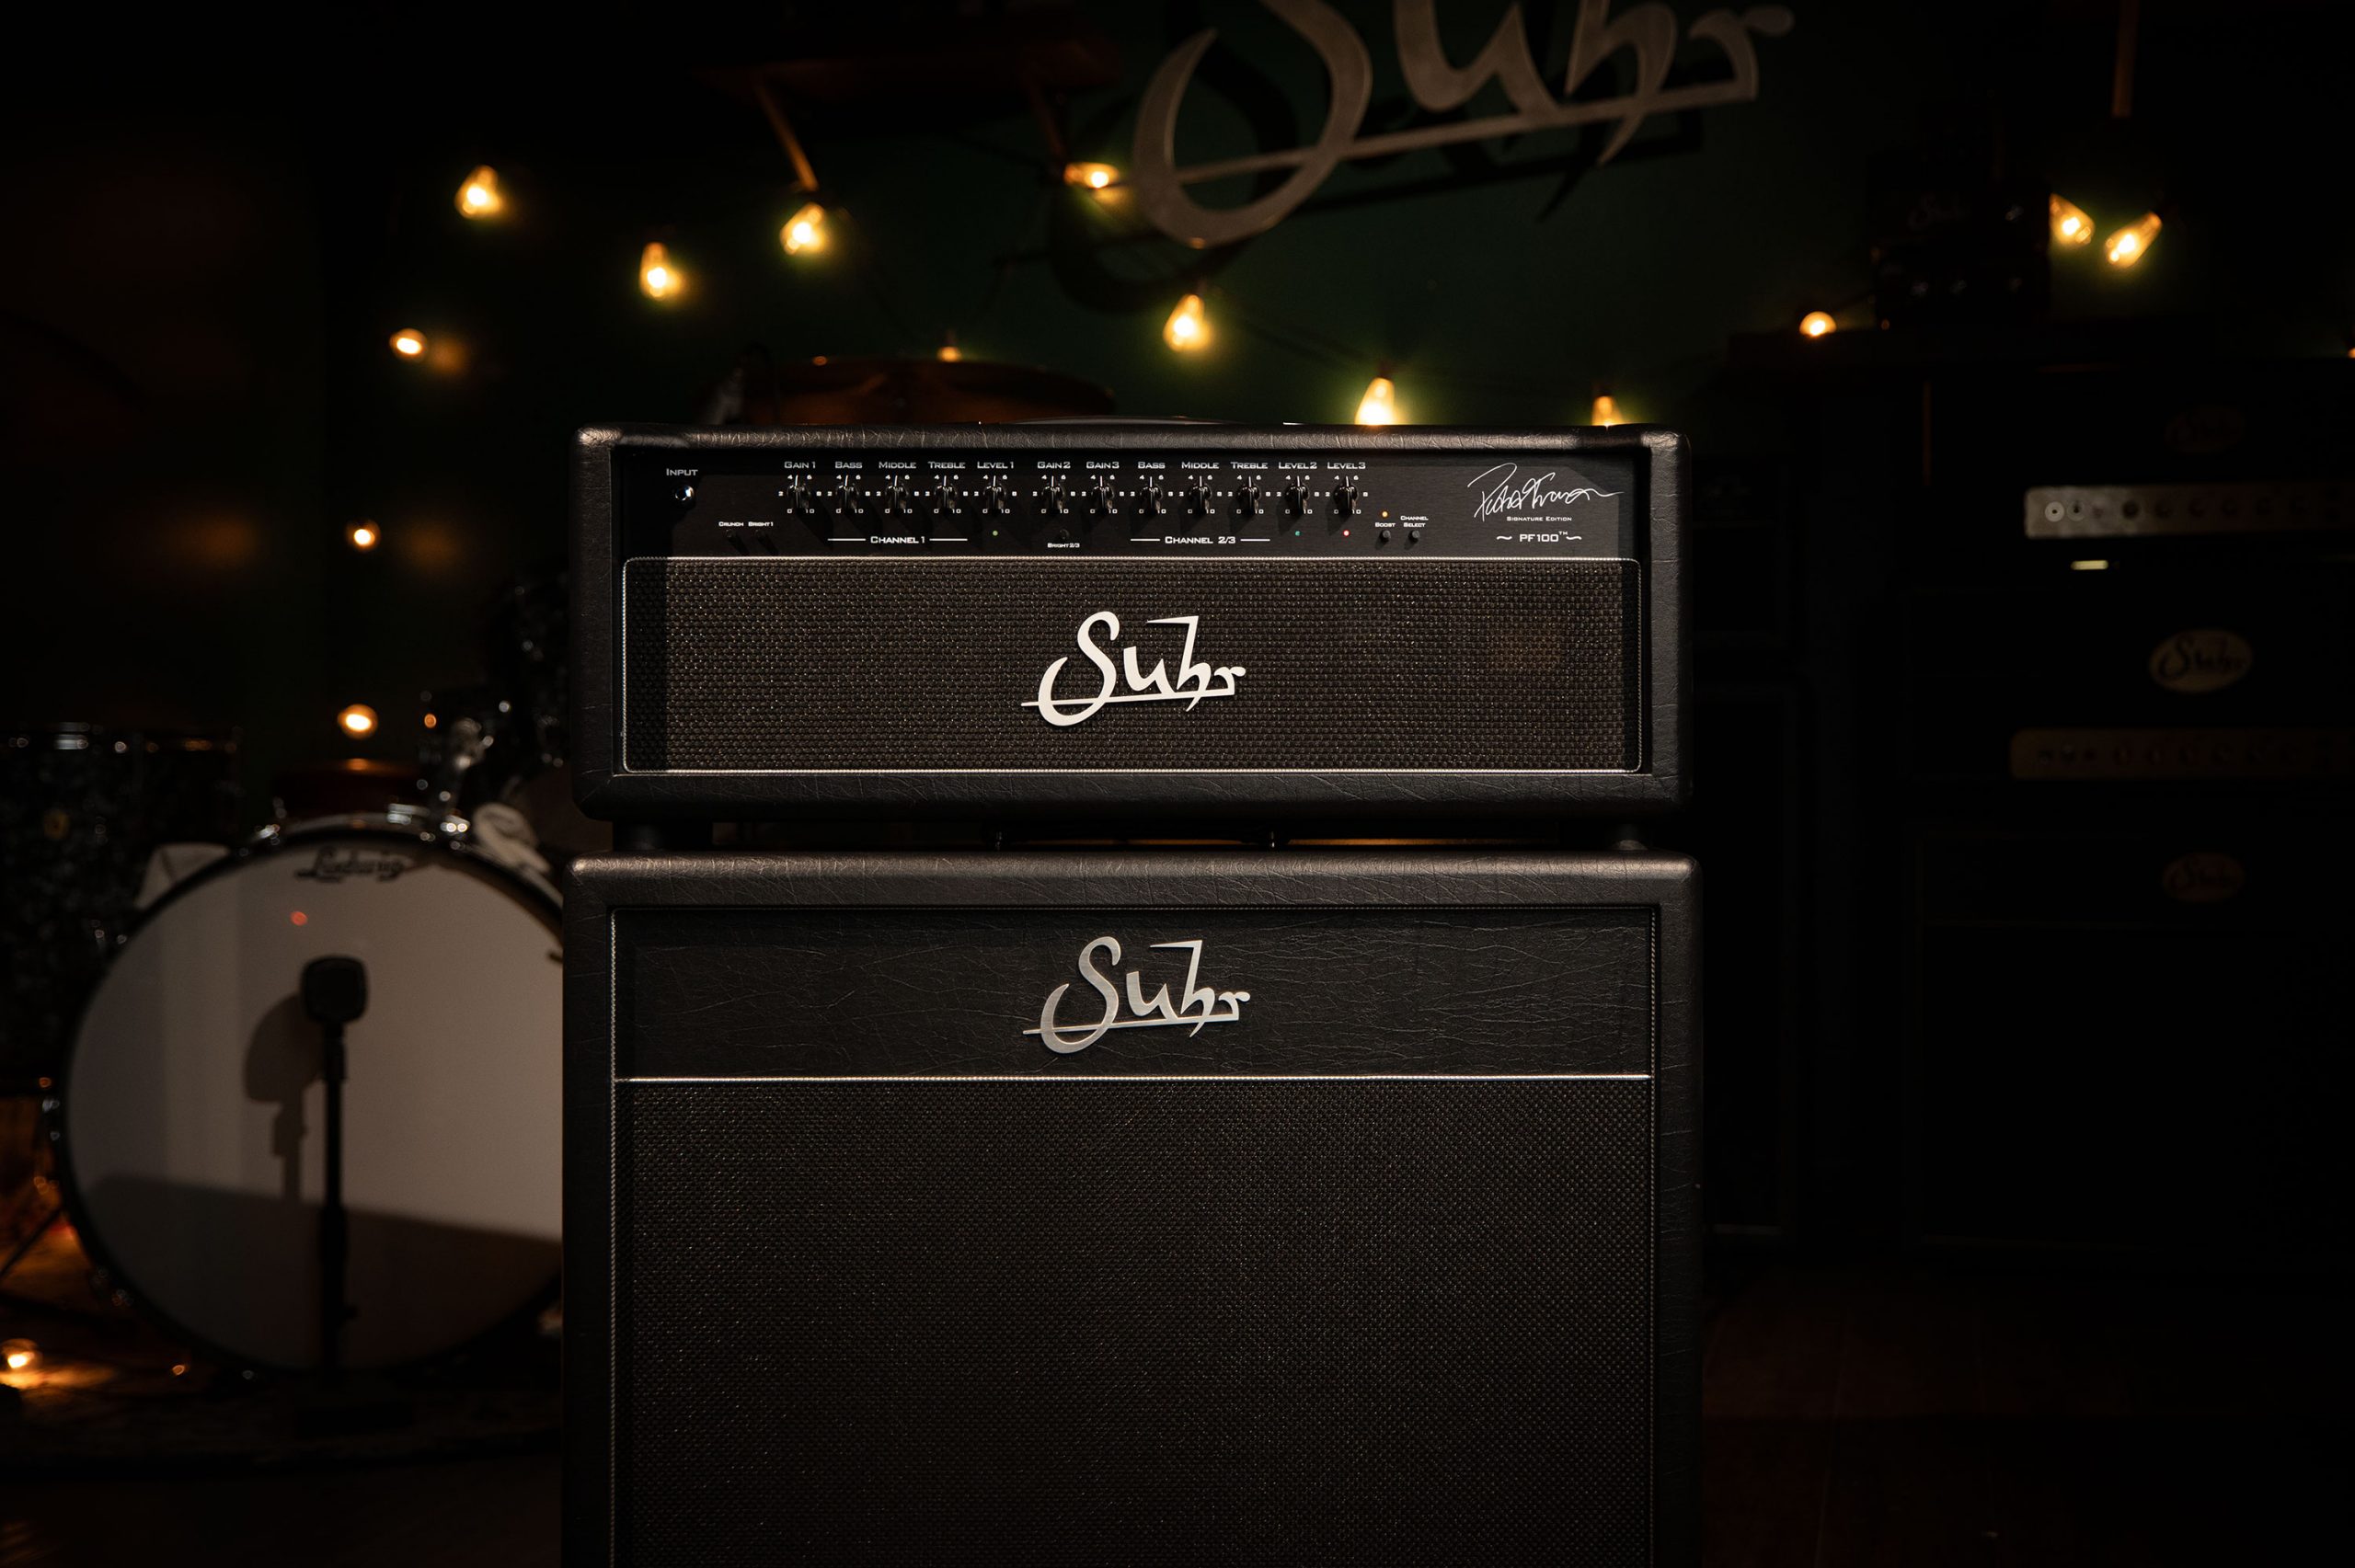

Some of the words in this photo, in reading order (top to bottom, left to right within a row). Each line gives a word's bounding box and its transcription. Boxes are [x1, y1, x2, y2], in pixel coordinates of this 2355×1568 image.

[1130, 0, 1796, 248] Suhr
[784, 461, 810, 469] GAIN
[811, 461, 816, 469] 1
[834, 461, 863, 469] BASS
[878, 461, 917, 469] MIDDLE
[927, 461, 966, 469] TREBLE
[976, 461, 1008, 469] LEVEL
[1009, 461, 1015, 469] 1
[1037, 461, 1063, 469] GAIN
[1063, 461, 1072, 469] 2
[1086, 461, 1111, 469] GAIN
[1111, 461, 1120, 469] 3
[1137, 461, 1166, 469] BASS
[1181, 462, 1220, 470] MIDDLE
[1230, 461, 1269, 470] TREBLE
[1278, 462, 1310, 470] LEVEL
[1309, 462, 1317, 470] 2
[1327, 462, 1359, 470] LEVEL
[1358, 462, 1366, 470] 3
[666, 468, 699, 476] INPUT
[870, 535, 920, 544] CHANNEL
[920, 535, 925, 544] 1
[1165, 535, 1214, 544] CHANNEL
[1217, 535, 1236, 544] 2/3
[1519, 533, 1559, 543] PF100
[1021, 611, 1246, 727] Suhr
[1022, 936, 1251, 1055] Suhr
